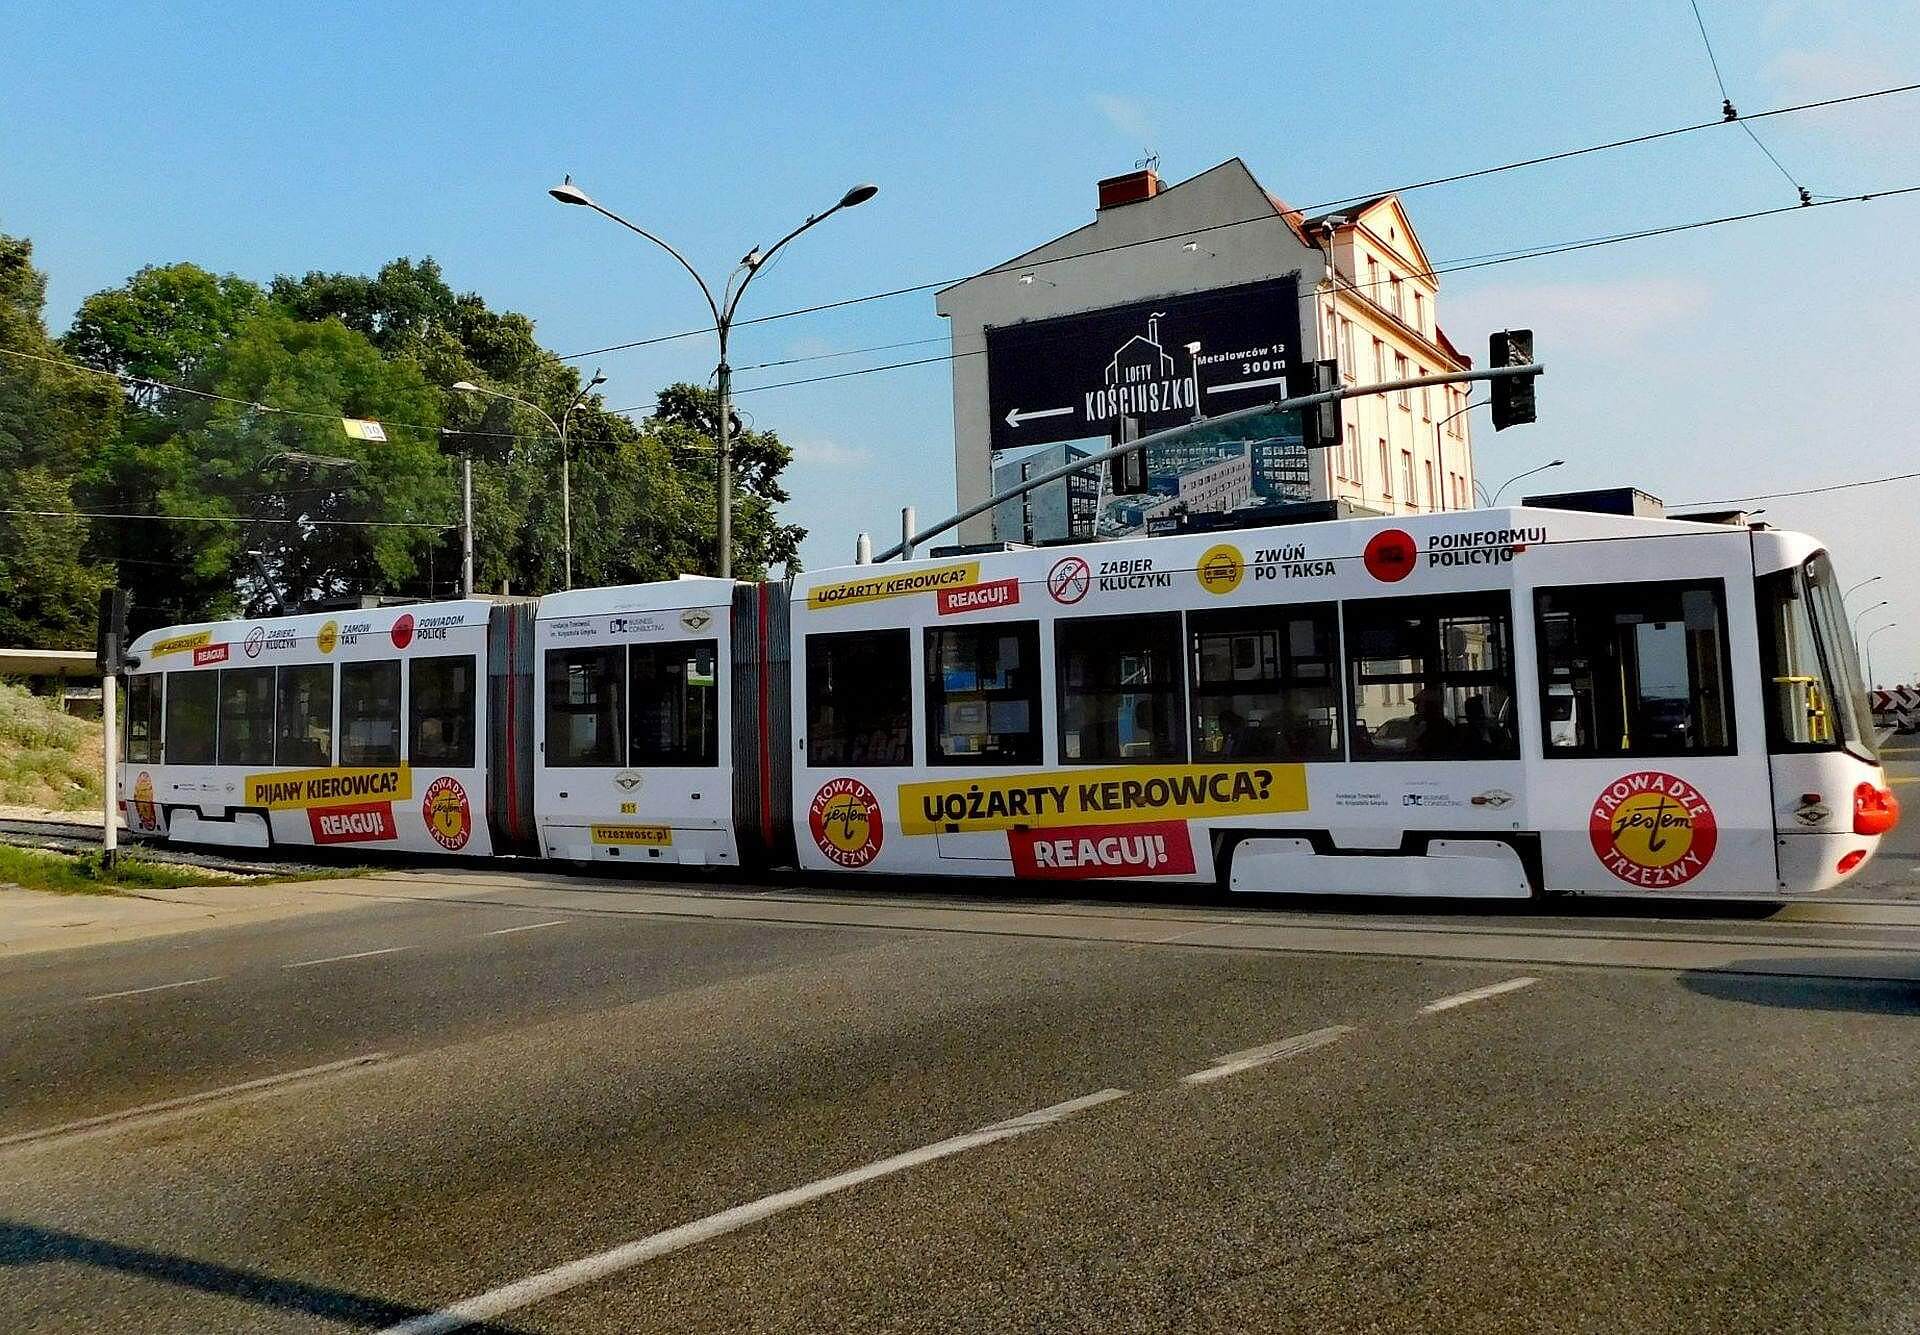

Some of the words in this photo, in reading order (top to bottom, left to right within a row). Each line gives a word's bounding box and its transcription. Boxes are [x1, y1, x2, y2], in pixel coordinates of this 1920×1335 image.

[1272, 343, 1285, 354] 13
[1125, 364, 1152, 383] LOFTY
[1085, 377, 1194, 422] KOŚCIUSZKO
[1429, 527, 1546, 549] POINFORMUJ
[886, 569, 966, 593] KEROWCA?
[1100, 573, 1171, 591] KLUCZYKI
[1255, 565, 1277, 581] PO
[1282, 561, 1337, 579] TAKSA
[948, 586, 1008, 608] REAGUJ!
[419, 615, 465, 628] POWIADOM
[341, 635, 357, 645] TAXI
[255, 781, 303, 805] PIJANY
[306, 771, 399, 800] KIEROWCA?
[923, 785, 1070, 822] UOŻARTY
[1079, 769, 1274, 812] KEROWCA?
[320, 811, 384, 836] REAGUJ!
[1612, 796, 1693, 852] jestem
[1033, 834, 1168, 870] REAGUJ!
